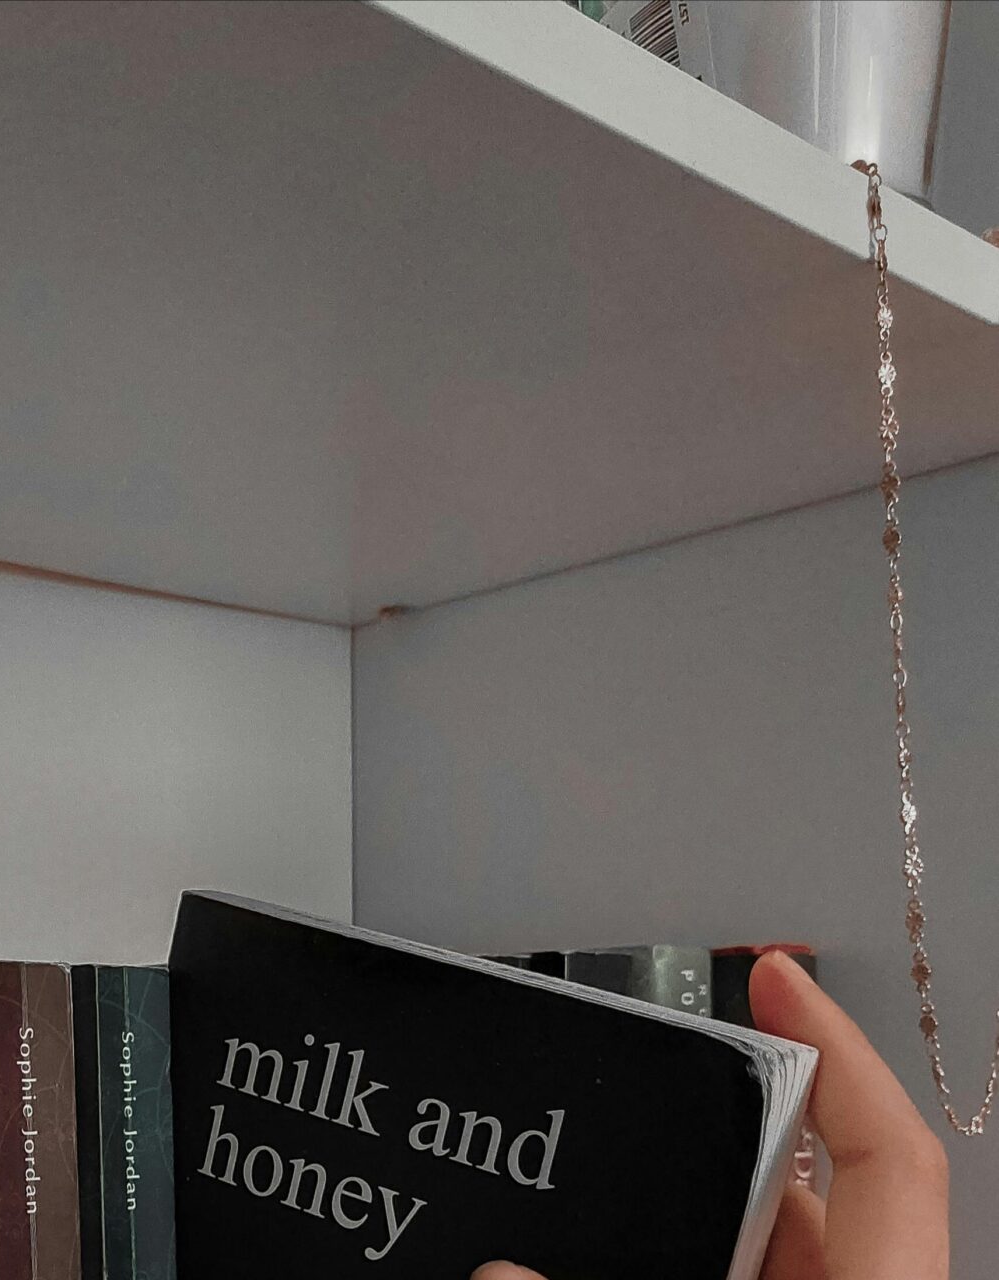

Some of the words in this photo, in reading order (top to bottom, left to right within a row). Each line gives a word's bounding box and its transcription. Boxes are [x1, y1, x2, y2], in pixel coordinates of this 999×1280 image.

[16, 1026, 40, 1119] Sophie
[116, 1029, 138, 1119] Sophie
[219, 1032, 392, 1138] milk
[408, 1089, 566, 1192] and
[20, 1128, 42, 1215] Jordan
[122, 1128, 140, 1212] Jordan
[198, 1104, 429, 1263] honey
